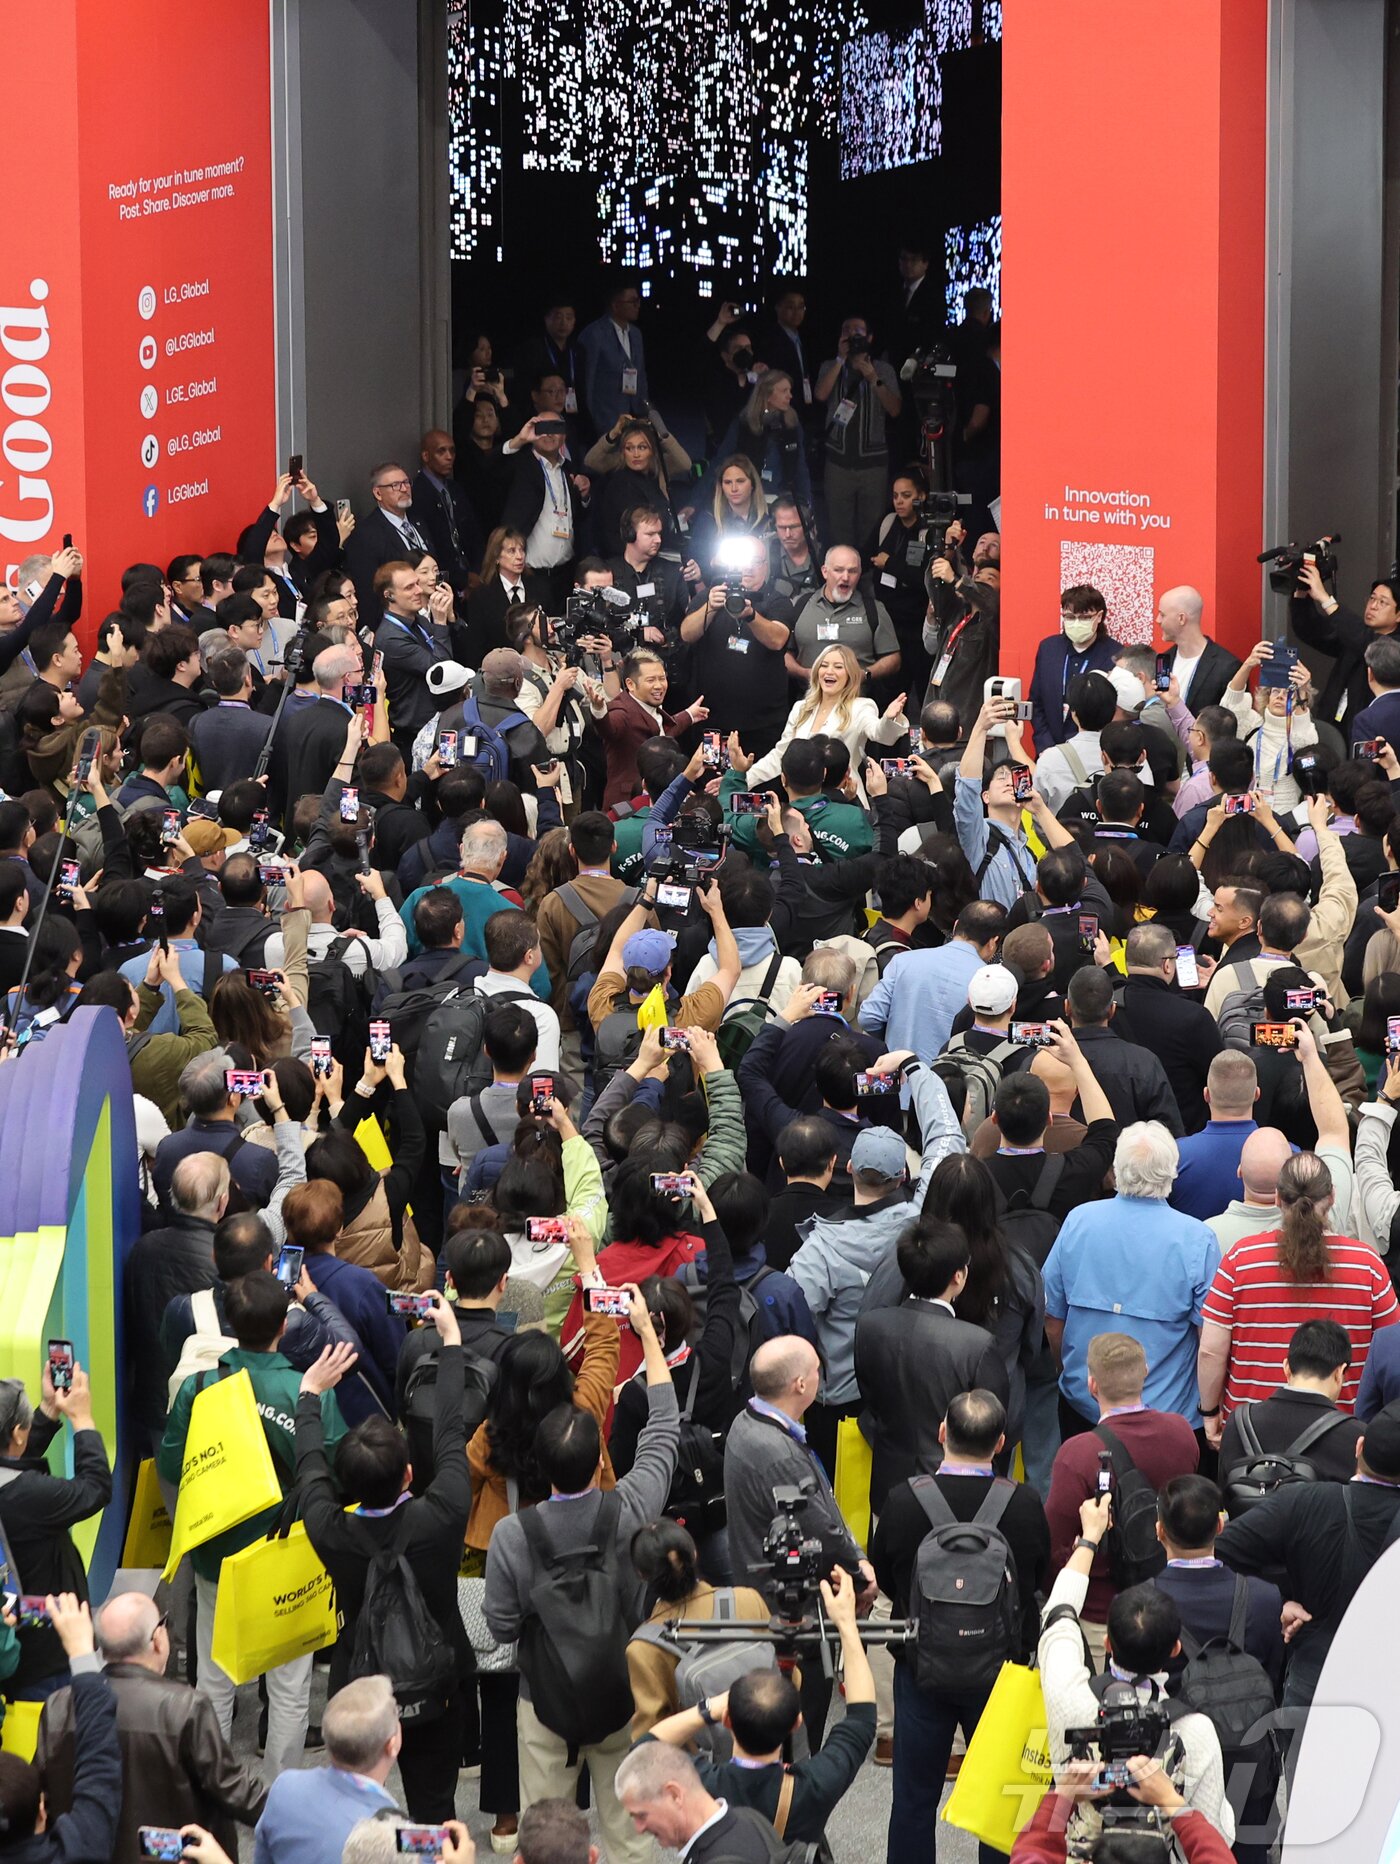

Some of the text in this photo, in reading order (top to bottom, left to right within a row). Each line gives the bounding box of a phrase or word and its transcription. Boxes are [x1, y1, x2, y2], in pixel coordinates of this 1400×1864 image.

[109, 156, 245, 200] Ready for your in tune moment?
[120, 184, 235, 220] Post. Share. Discover more.
[164, 278, 209, 304] LG_Global
[165, 327, 215, 357] @LGGlobal
[166, 377, 217, 405] LGE_Global
[167, 425, 221, 457] @LG_Global
[168, 478, 209, 504] LGGlobal
[1064, 485, 1150, 508] Innovation
[1044, 503, 1171, 530] in tune with you
[618, 852, 643, 873] K-STA
[200, 1441, 224, 1460] NO.1
[273, 1574, 322, 1606] WORLD'S
[274, 1601, 305, 1618] SELLING
[1021, 1743, 1052, 1769] Insta3
